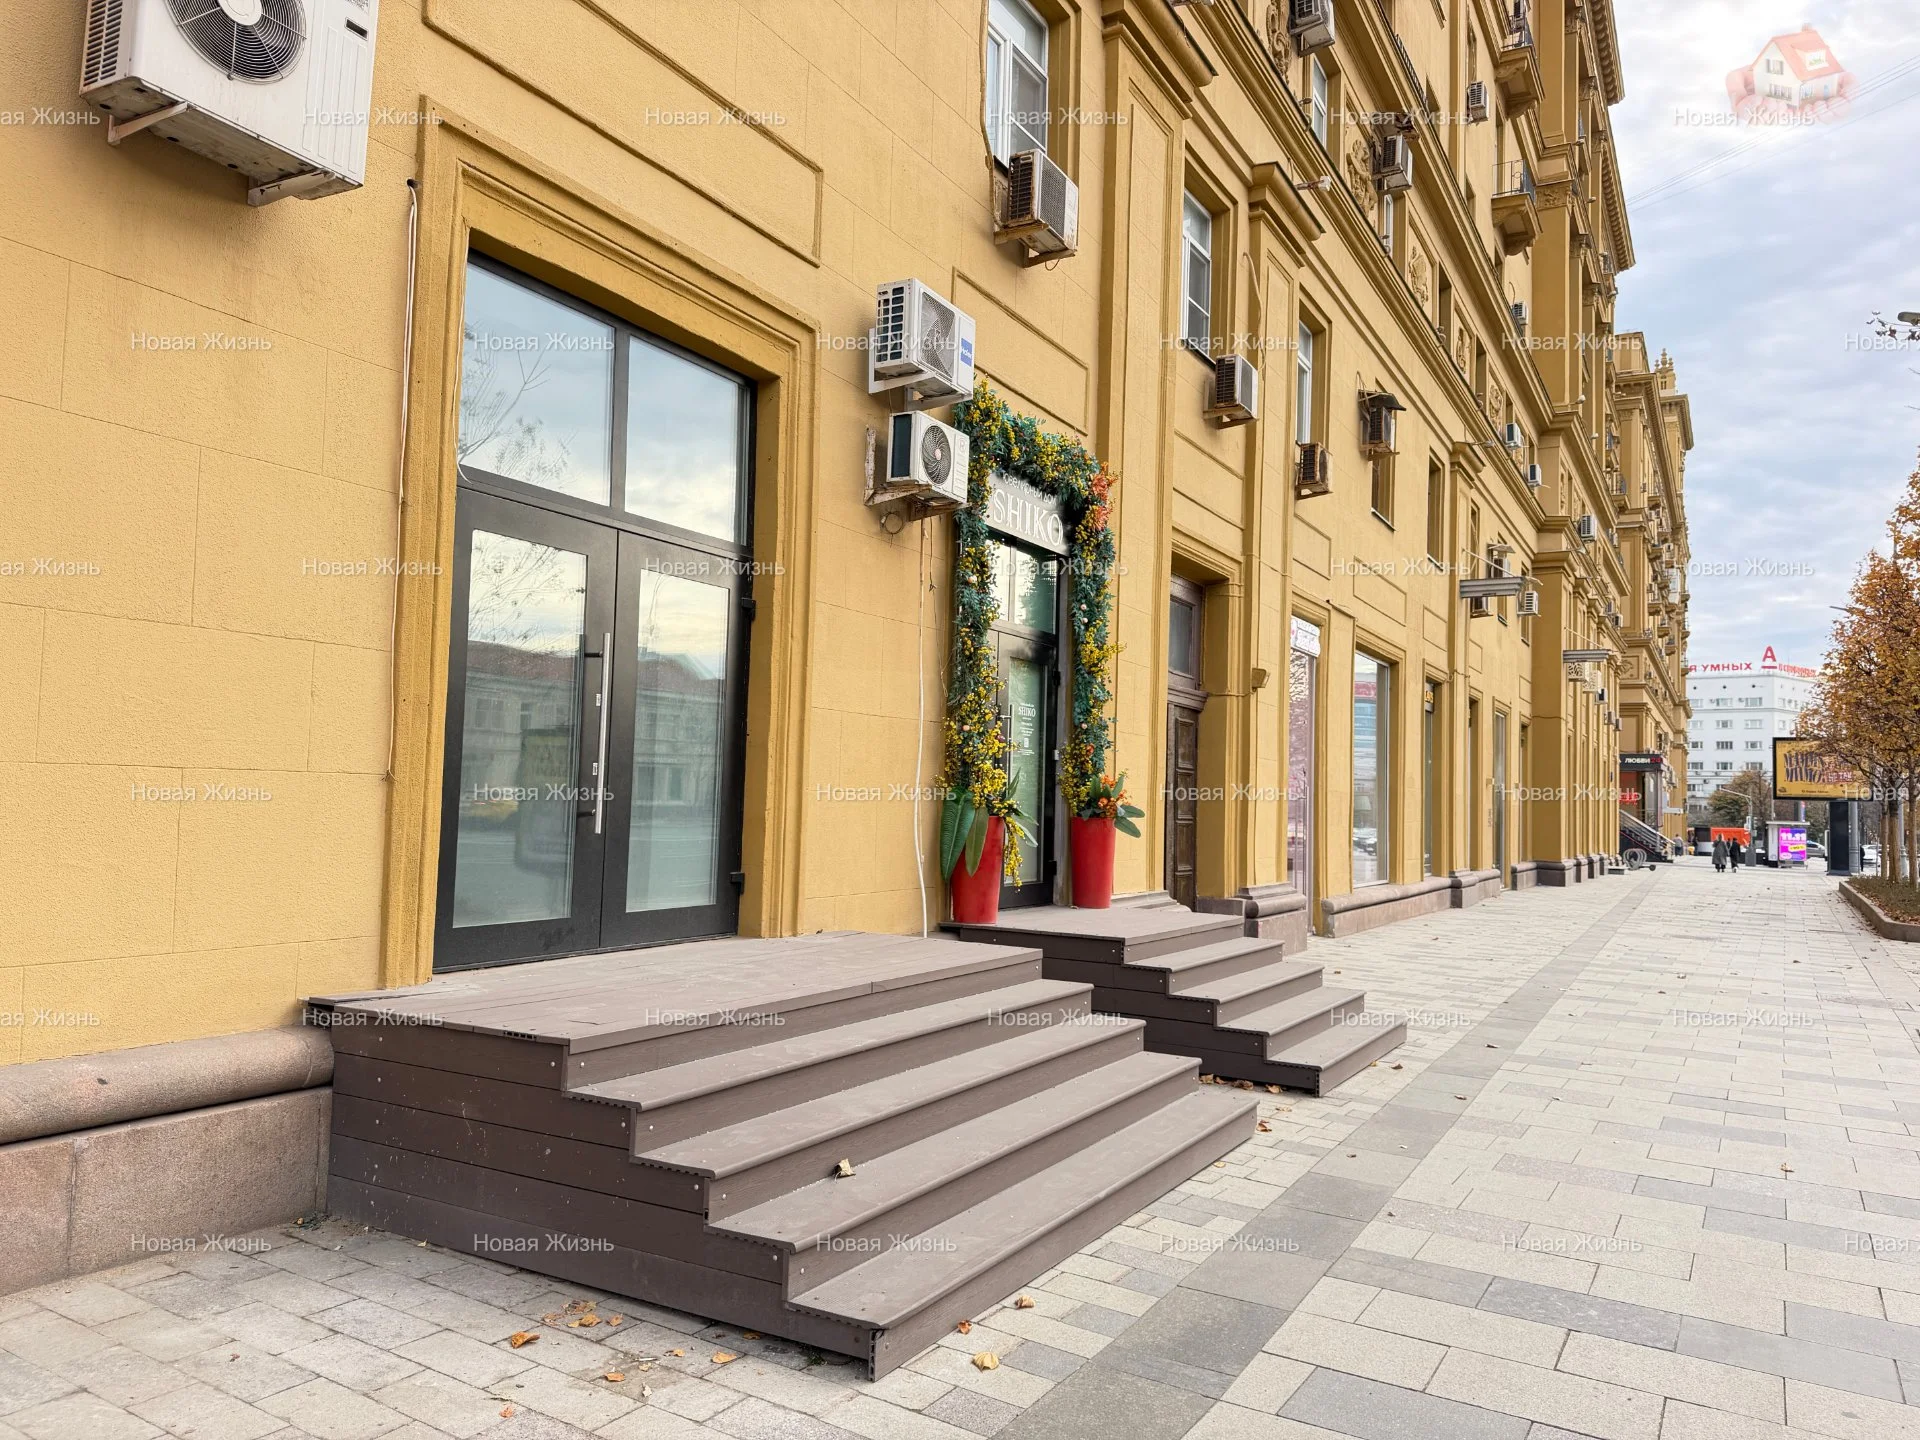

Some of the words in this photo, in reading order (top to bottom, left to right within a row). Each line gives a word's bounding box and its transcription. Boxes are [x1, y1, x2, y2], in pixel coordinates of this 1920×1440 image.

[993, 488, 1064, 546] SHIKO
[1701, 662, 1753, 673] УМНЫХ
[1018, 706, 1036, 717] SHIKO
